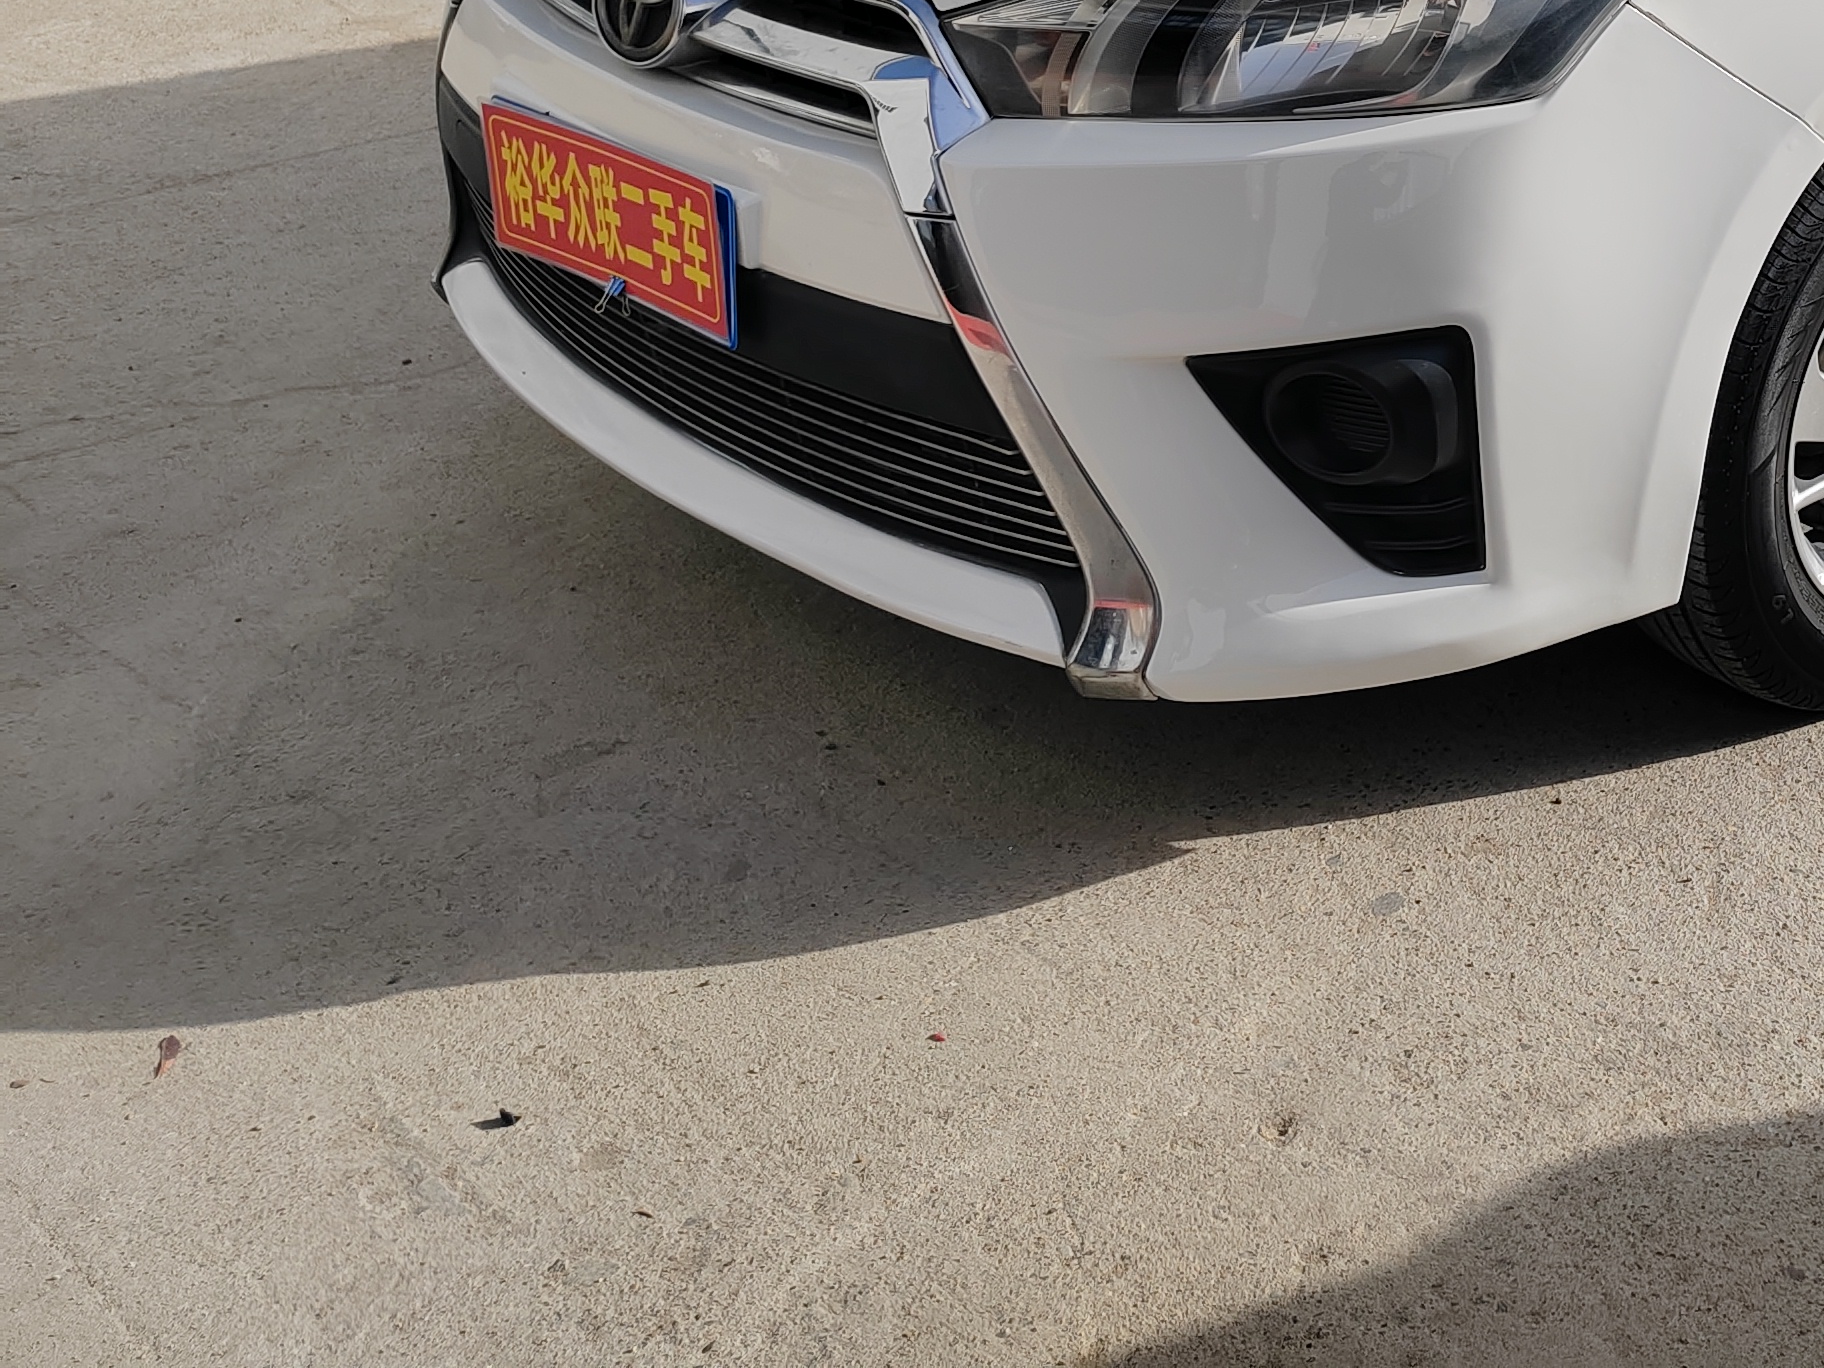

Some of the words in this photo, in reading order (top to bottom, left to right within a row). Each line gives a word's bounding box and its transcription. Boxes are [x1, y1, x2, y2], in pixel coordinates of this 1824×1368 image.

[501, 129, 711, 301] 裕华众联二手车
